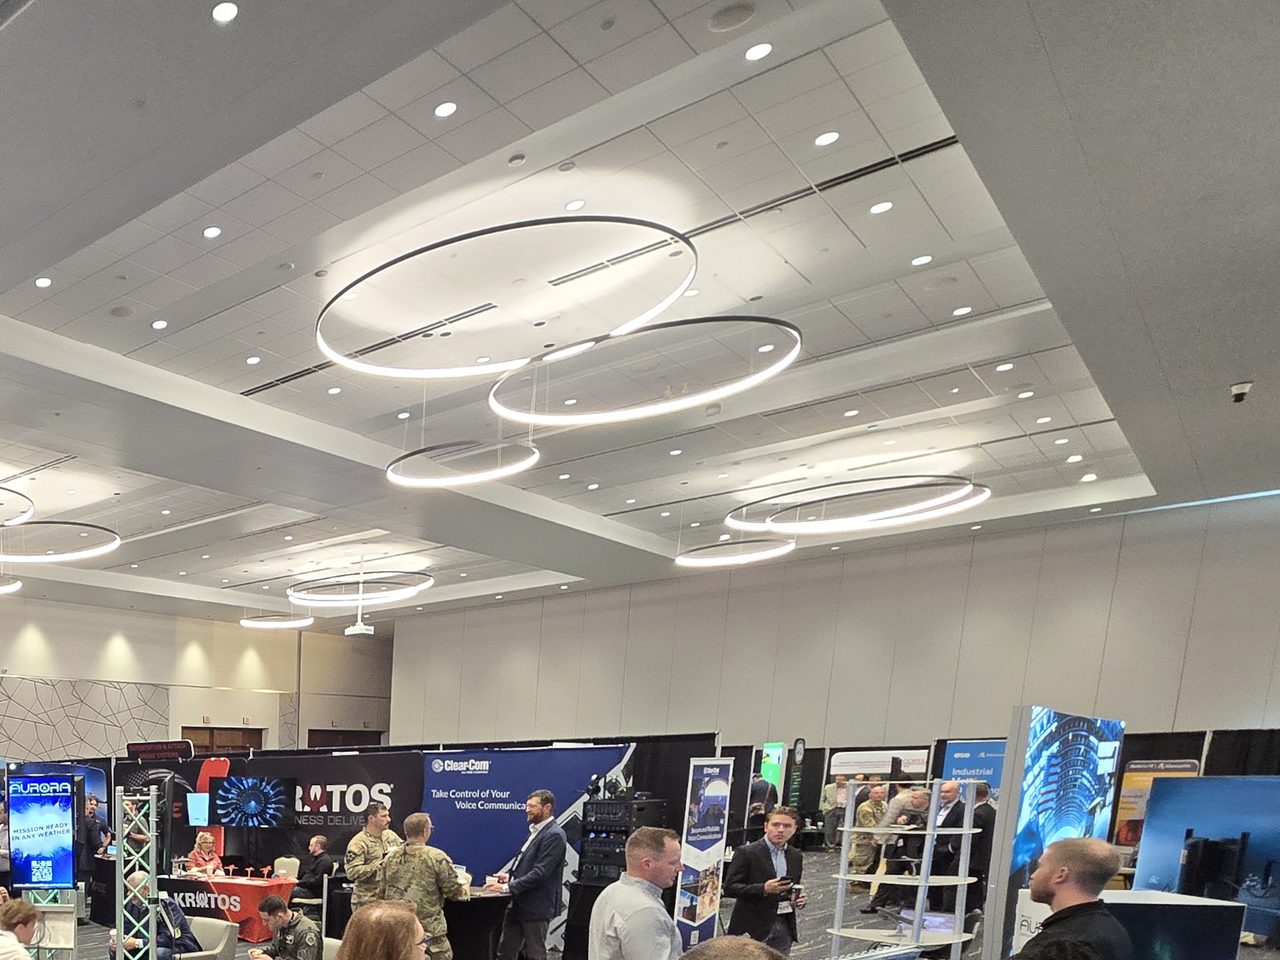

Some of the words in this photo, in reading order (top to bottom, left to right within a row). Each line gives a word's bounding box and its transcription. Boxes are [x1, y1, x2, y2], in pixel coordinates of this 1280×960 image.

[444, 759, 489, 771] Clear-Com
[952, 767, 993, 776] Industrial
[9, 782, 72, 794] AURORA
[431, 789, 449, 798] Take
[449, 789, 480, 798] Control
[481, 789, 490, 798] of
[490, 789, 510, 798] Your
[455, 800, 477, 810] Voice
[478, 800, 526, 811] Communica
[13, 825, 44, 834] MISSION
[46, 822, 68, 831] READY
[21, 833, 36, 841] ANY
[37, 828, 71, 838] WEATHER
[173, 891, 241, 912] KRATOS
